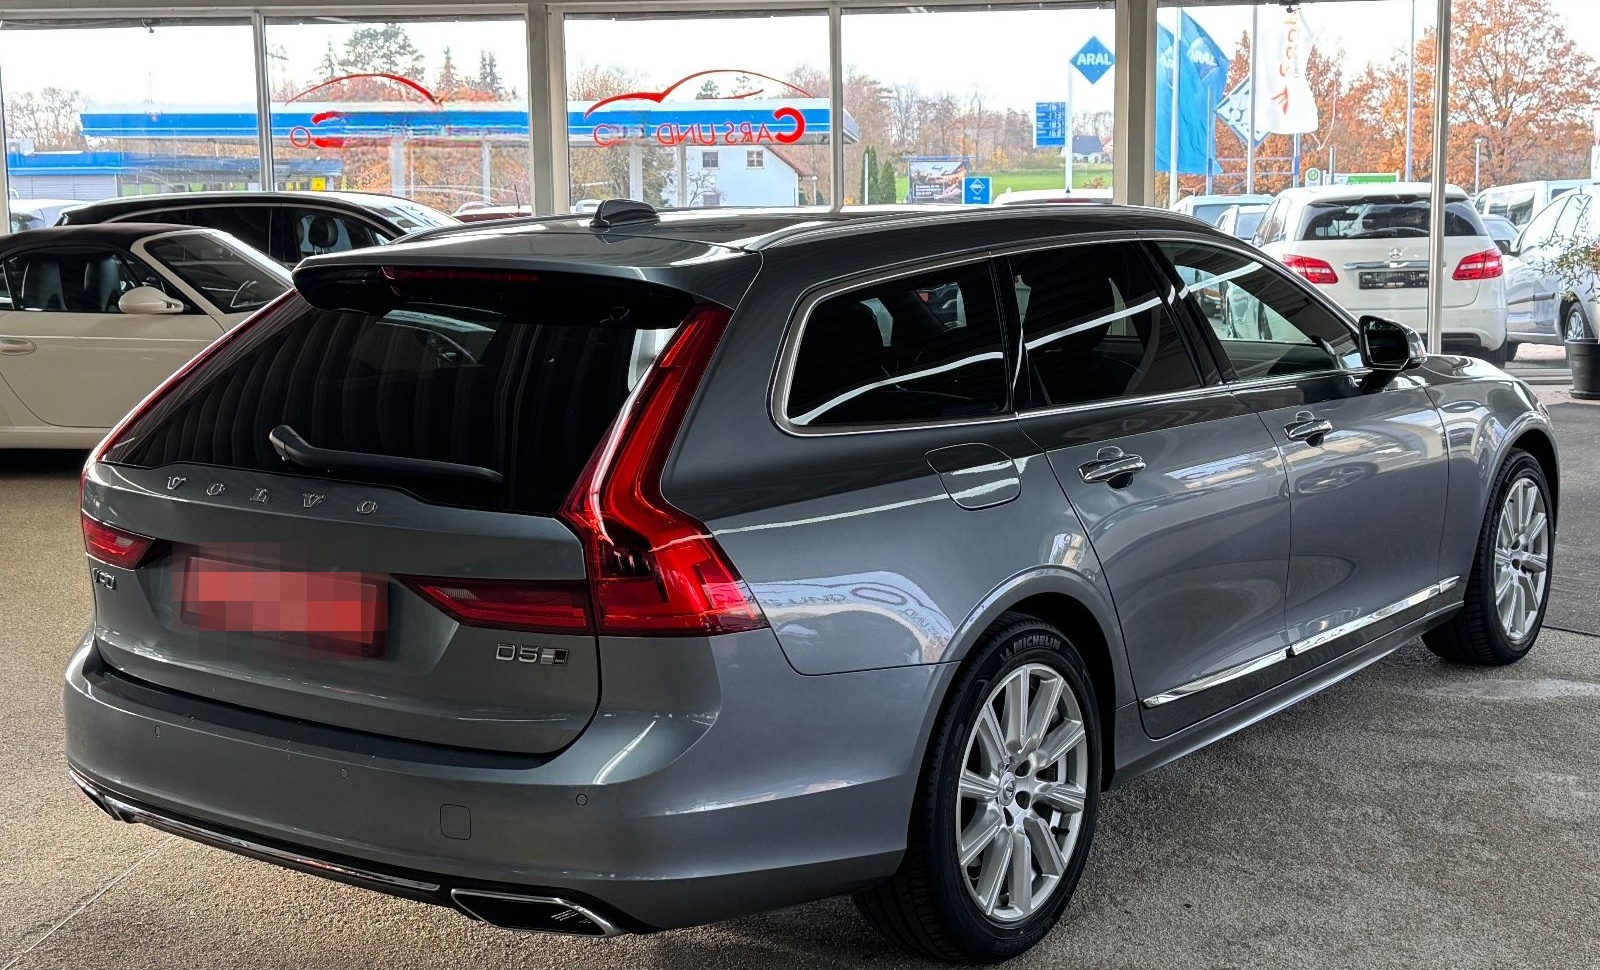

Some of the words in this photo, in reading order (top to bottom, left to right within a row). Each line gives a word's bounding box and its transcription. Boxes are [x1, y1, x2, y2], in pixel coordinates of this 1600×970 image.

[1077, 53, 1112, 66] ARAL
[167, 476, 378, 514] VOLVO
[495, 643, 539, 663] D5
[1013, 634, 1061, 654] MICHELIN
